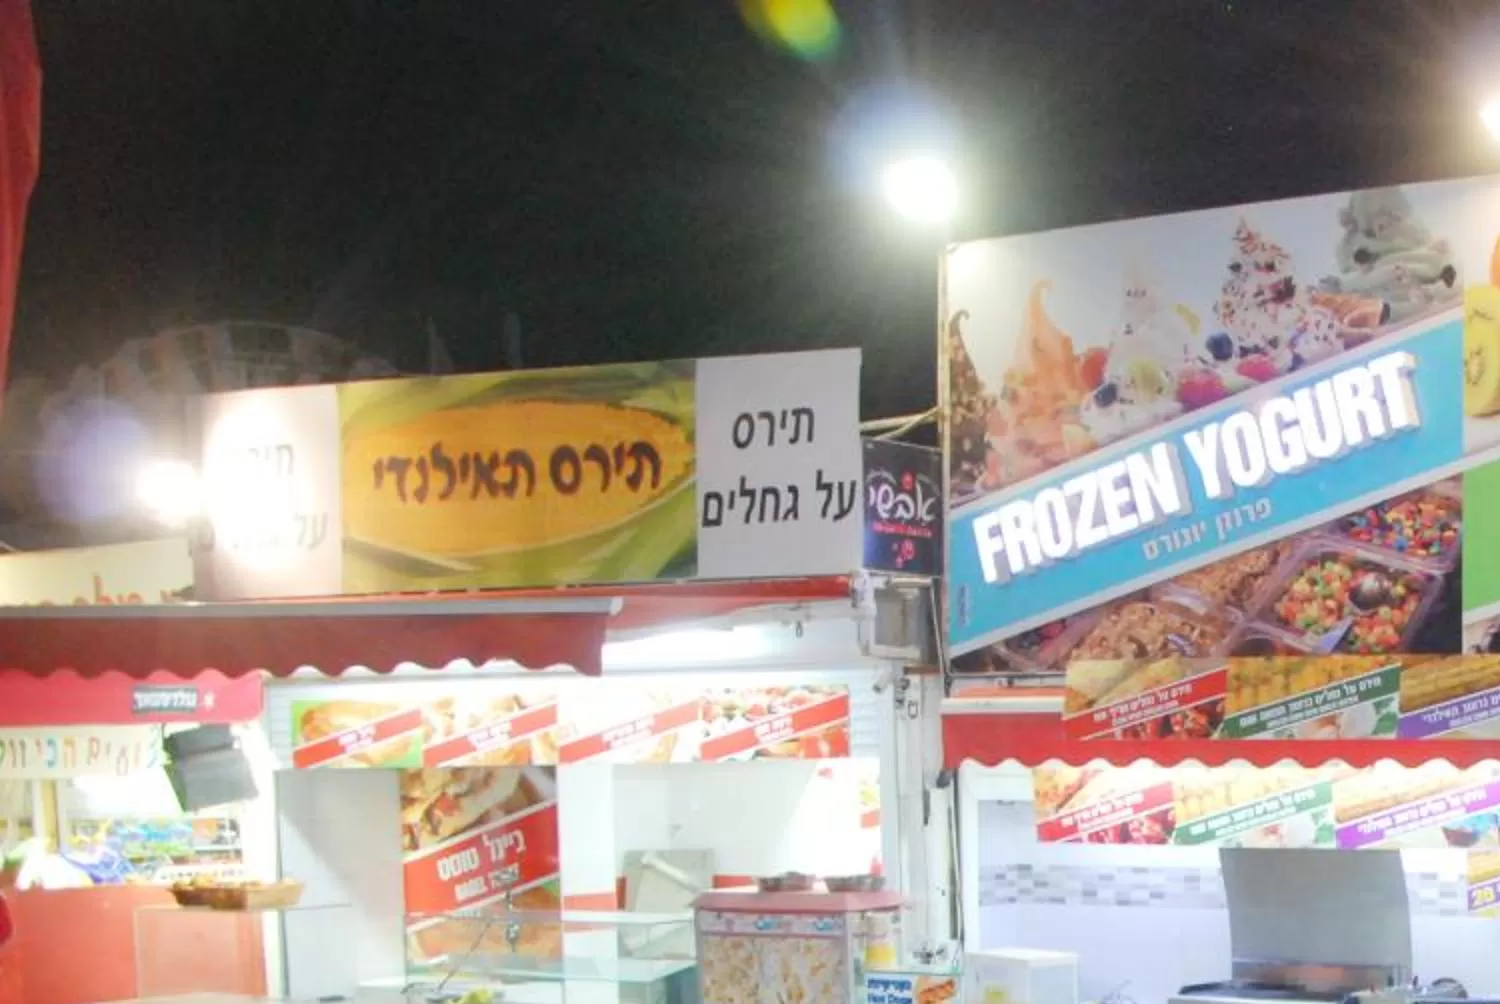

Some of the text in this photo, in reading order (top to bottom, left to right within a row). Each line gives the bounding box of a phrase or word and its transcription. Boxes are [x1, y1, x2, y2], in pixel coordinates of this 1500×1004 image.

[732, 406, 815, 449] תירס
[373, 440, 662, 505] תירס תאילנדי
[971, 350, 1420, 585] FROZEN YOGURT
[702, 469, 857, 529] על גחלים
